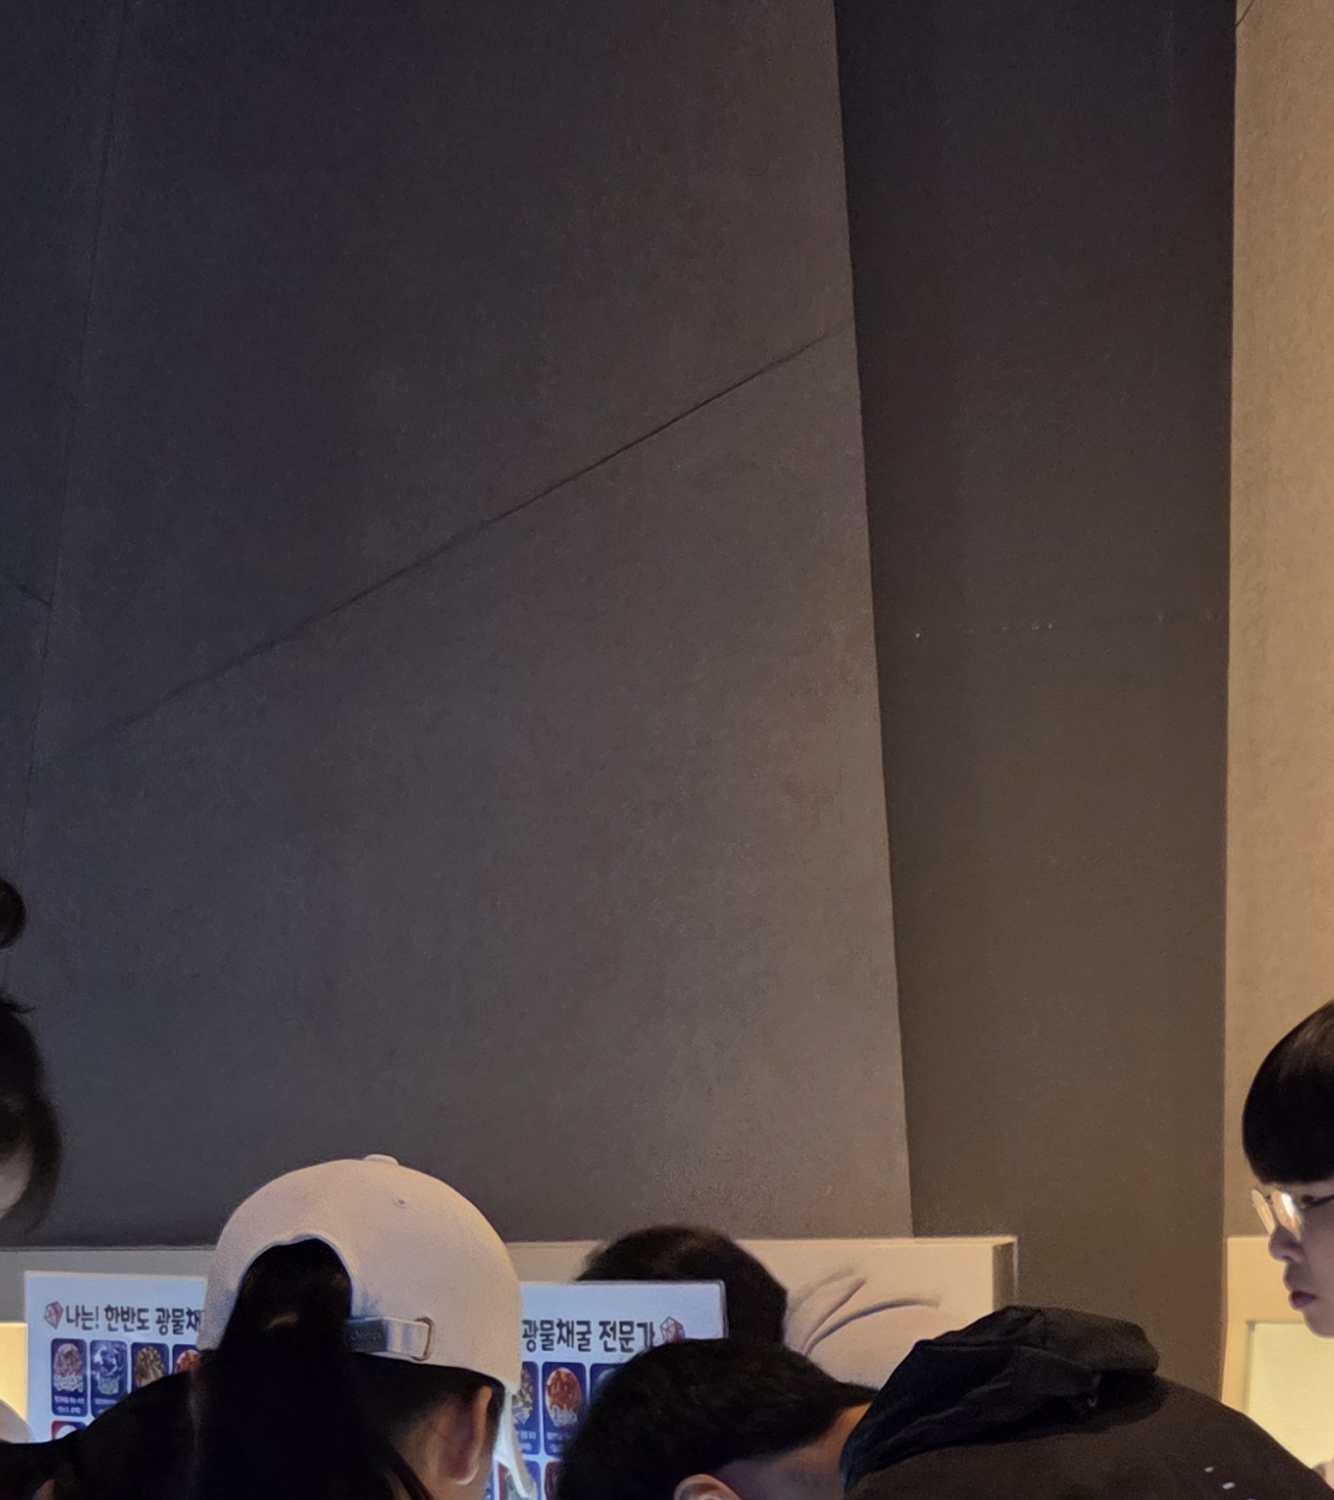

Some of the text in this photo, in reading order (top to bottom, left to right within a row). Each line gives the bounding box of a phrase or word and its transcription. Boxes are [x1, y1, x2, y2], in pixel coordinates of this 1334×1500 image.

[65, 1304, 100, 1331] 나는!
[104, 1303, 150, 1332] 한반도
[522, 1318, 656, 1353] 광물채굴 전문가
